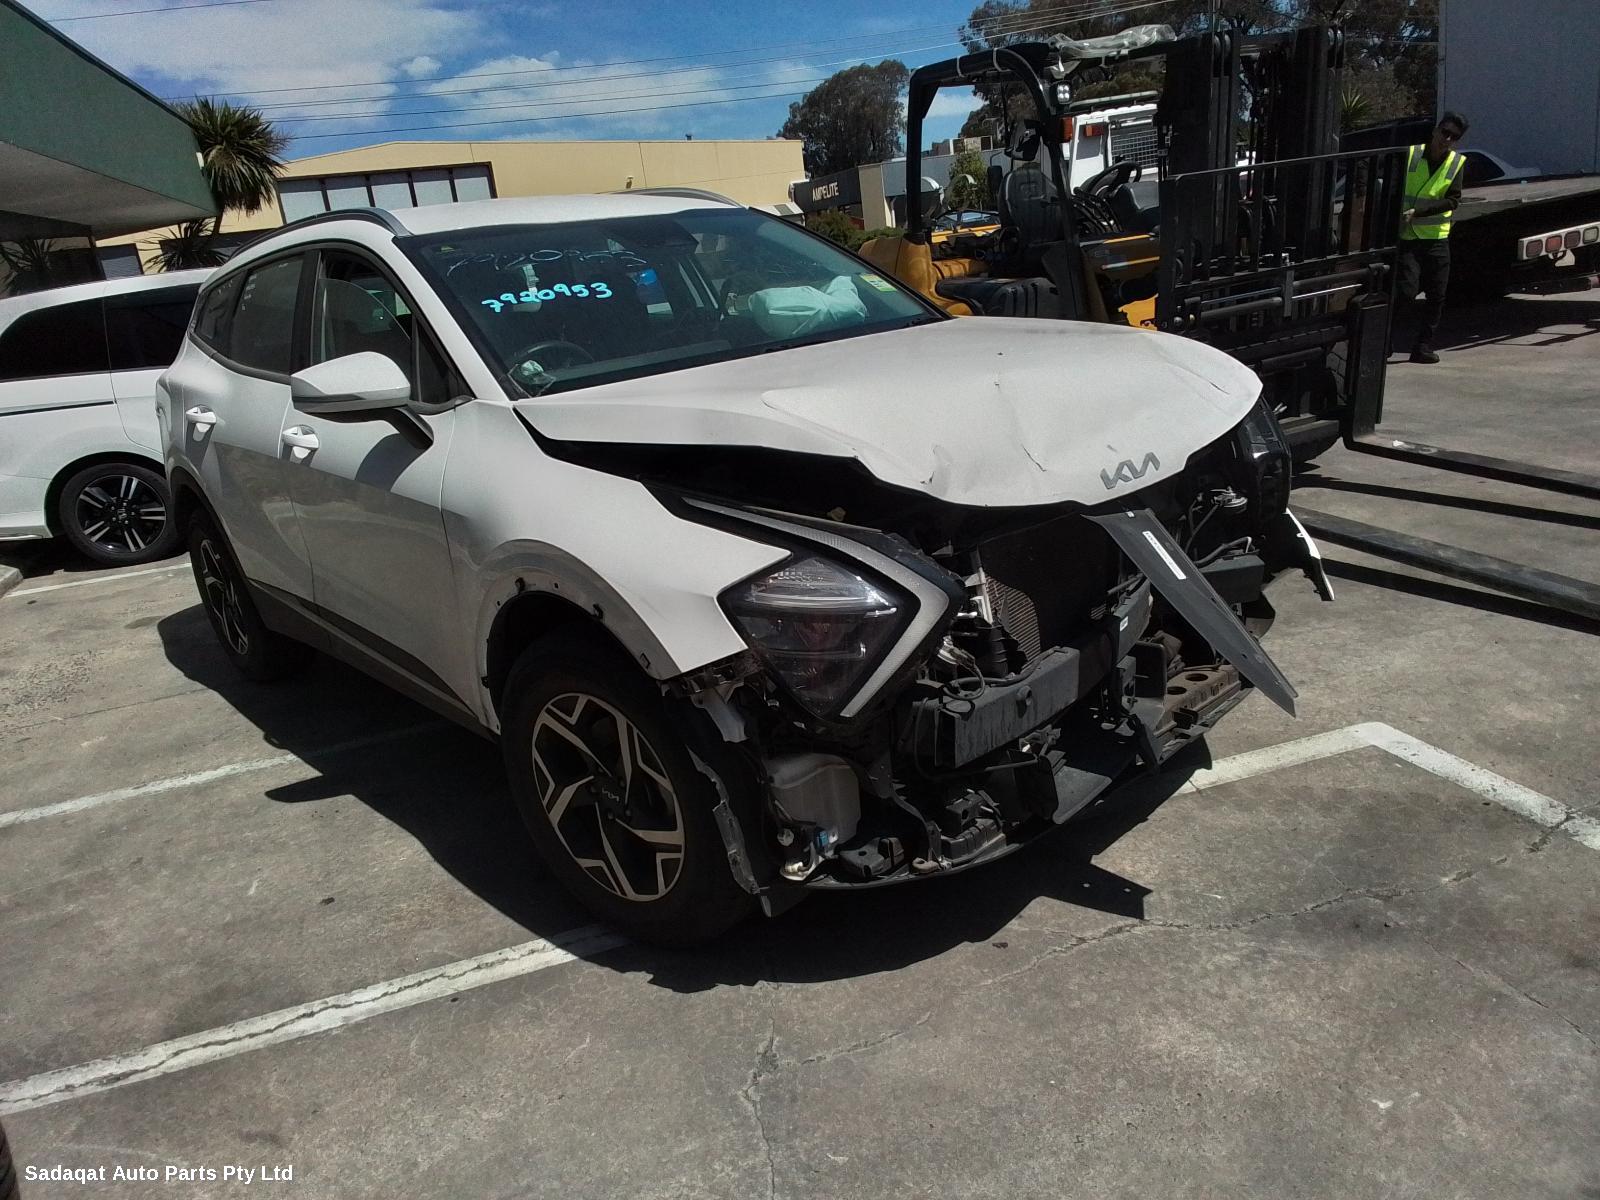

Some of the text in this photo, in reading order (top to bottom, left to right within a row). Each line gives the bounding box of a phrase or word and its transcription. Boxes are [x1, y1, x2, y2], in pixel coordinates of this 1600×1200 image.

[812, 181, 839, 202] AMPELITE
[481, 282, 612, 313] 7920953
[1100, 451, 1160, 490] KIA
